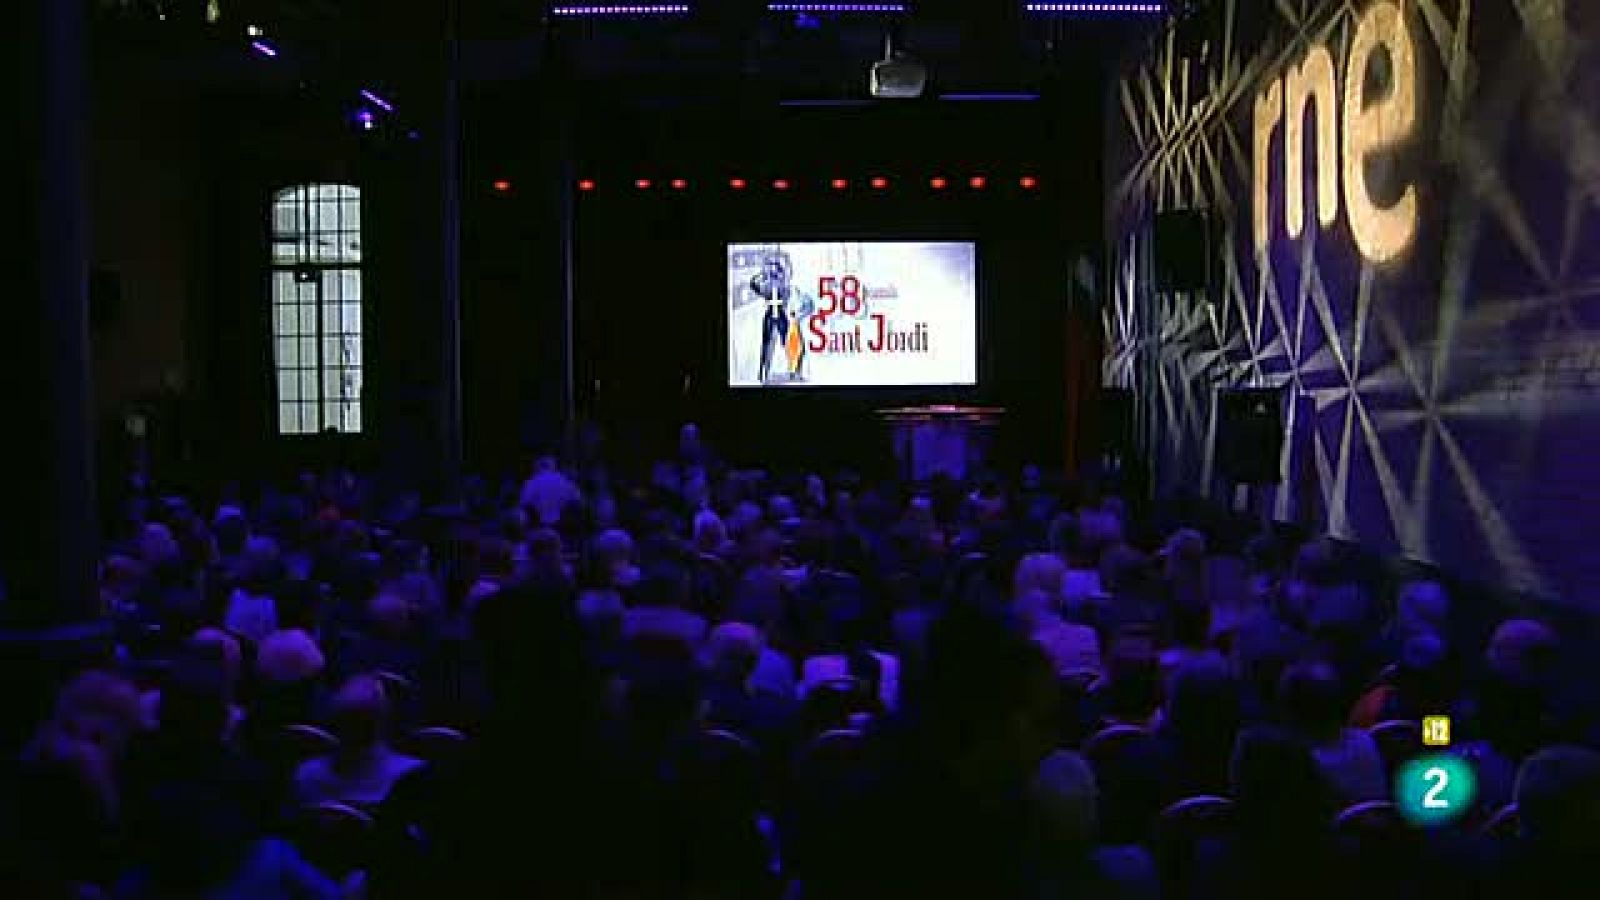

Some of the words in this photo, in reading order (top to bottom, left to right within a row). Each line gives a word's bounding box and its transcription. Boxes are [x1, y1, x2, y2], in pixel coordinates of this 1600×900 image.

[1253, 1, 1417, 262] rne
[818, 275, 862, 316] 58
[809, 313, 863, 353] Sant
[867, 313, 929, 353] Jordi
